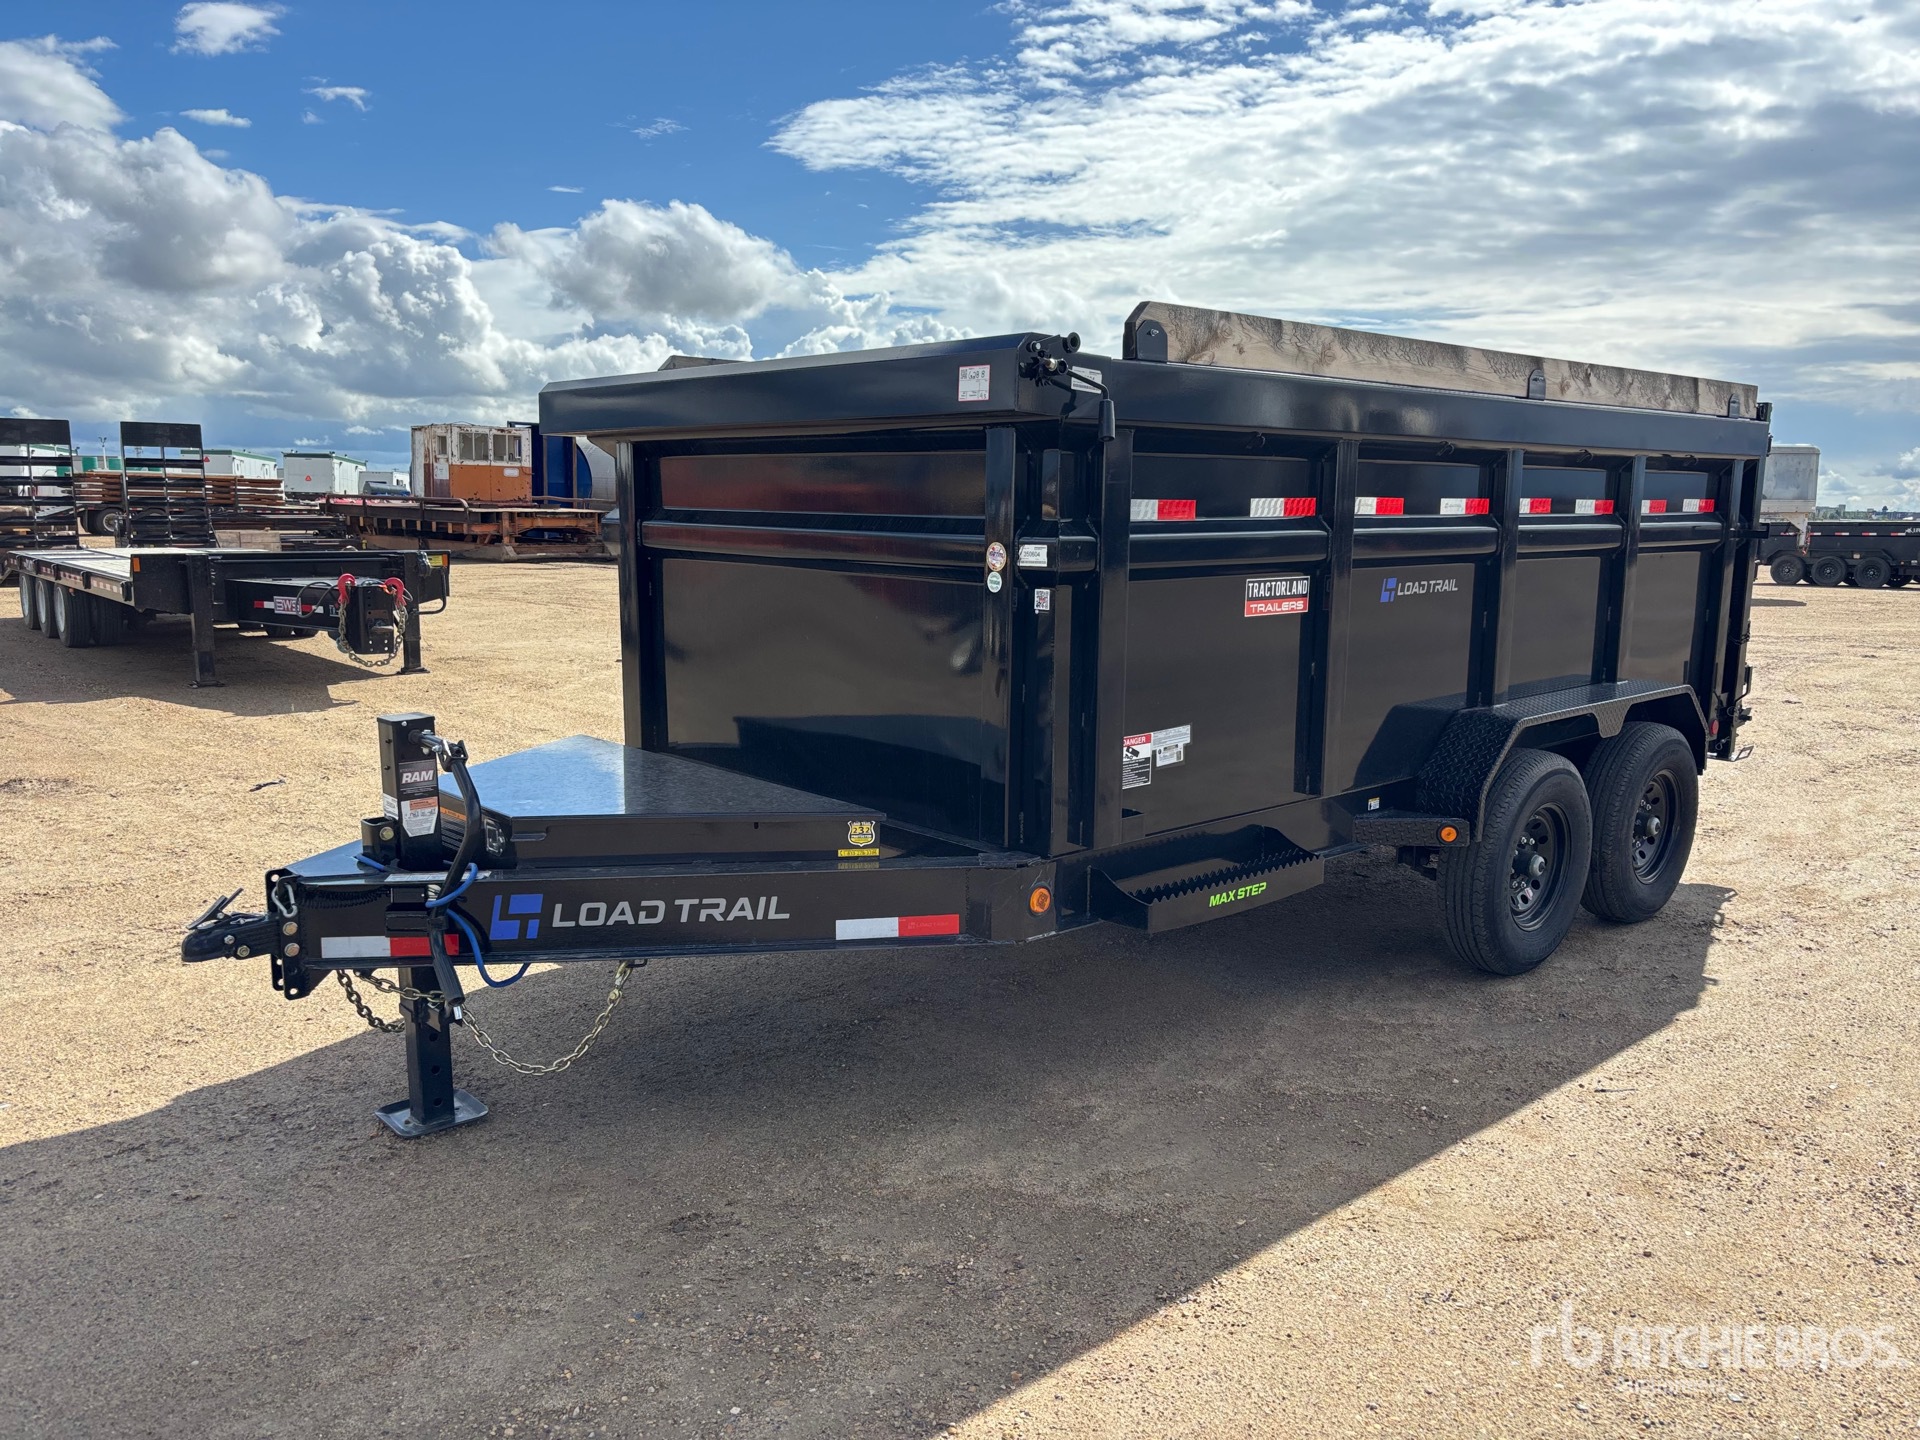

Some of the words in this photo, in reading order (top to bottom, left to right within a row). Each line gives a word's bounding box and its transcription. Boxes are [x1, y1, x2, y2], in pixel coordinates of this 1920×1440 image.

[1248, 580, 1308, 598] TRACTORLAND
[1397, 581, 1427, 596] LOAD
[1429, 578, 1459, 593] TRAIL
[1250, 600, 1304, 613] TRAILERS
[401, 770, 434, 784] RAM
[1209, 889, 1236, 907] MAX
[1237, 881, 1267, 900] STEP
[552, 900, 665, 928] LOAD
[674, 896, 790, 923] TRAIL
